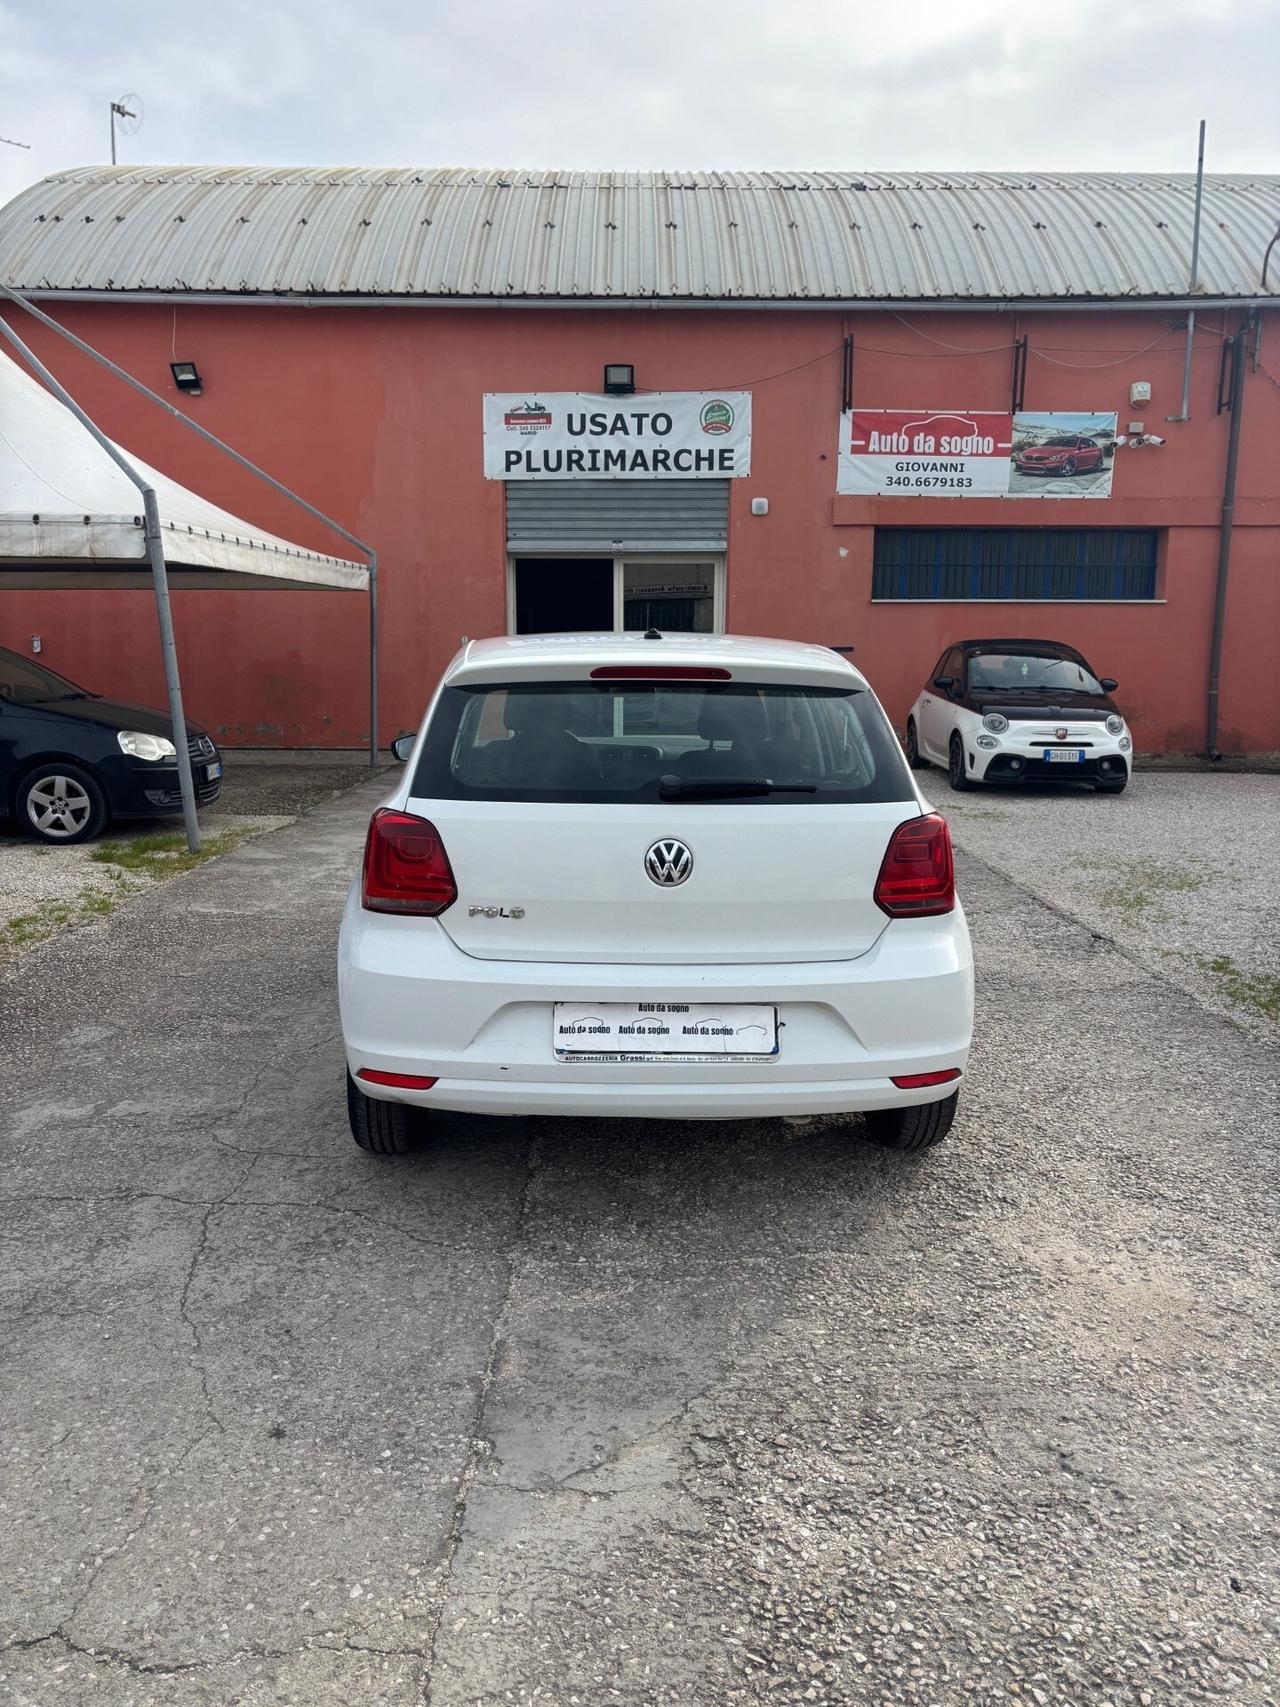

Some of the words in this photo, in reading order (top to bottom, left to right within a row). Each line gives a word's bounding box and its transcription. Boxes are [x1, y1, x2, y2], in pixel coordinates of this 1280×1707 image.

[566, 412, 673, 436] USATO
[868, 431, 909, 453] Auto
[913, 431, 935, 453] da
[939, 434, 994, 456] sogno
[504, 448, 735, 473] PLURIMARCHE
[895, 462, 965, 473] GIOVANNI
[885, 476, 973, 488] 340.6679183
[468, 905, 526, 919] POLO
[638, 1003, 654, 1012] Auto
[656, 1003, 665, 1012] da
[666, 1004, 690, 1014] sogno
[559, 1025, 576, 1034] Auto
[578, 1025, 586, 1034] da
[618, 1025, 635, 1035] Auto
[636, 1025, 646, 1035] da
[647, 1026, 670, 1036] sogno
[682, 1026, 698, 1035] Auto
[700, 1026, 709, 1035] da
[620, 1054, 645, 1062] Grassi
